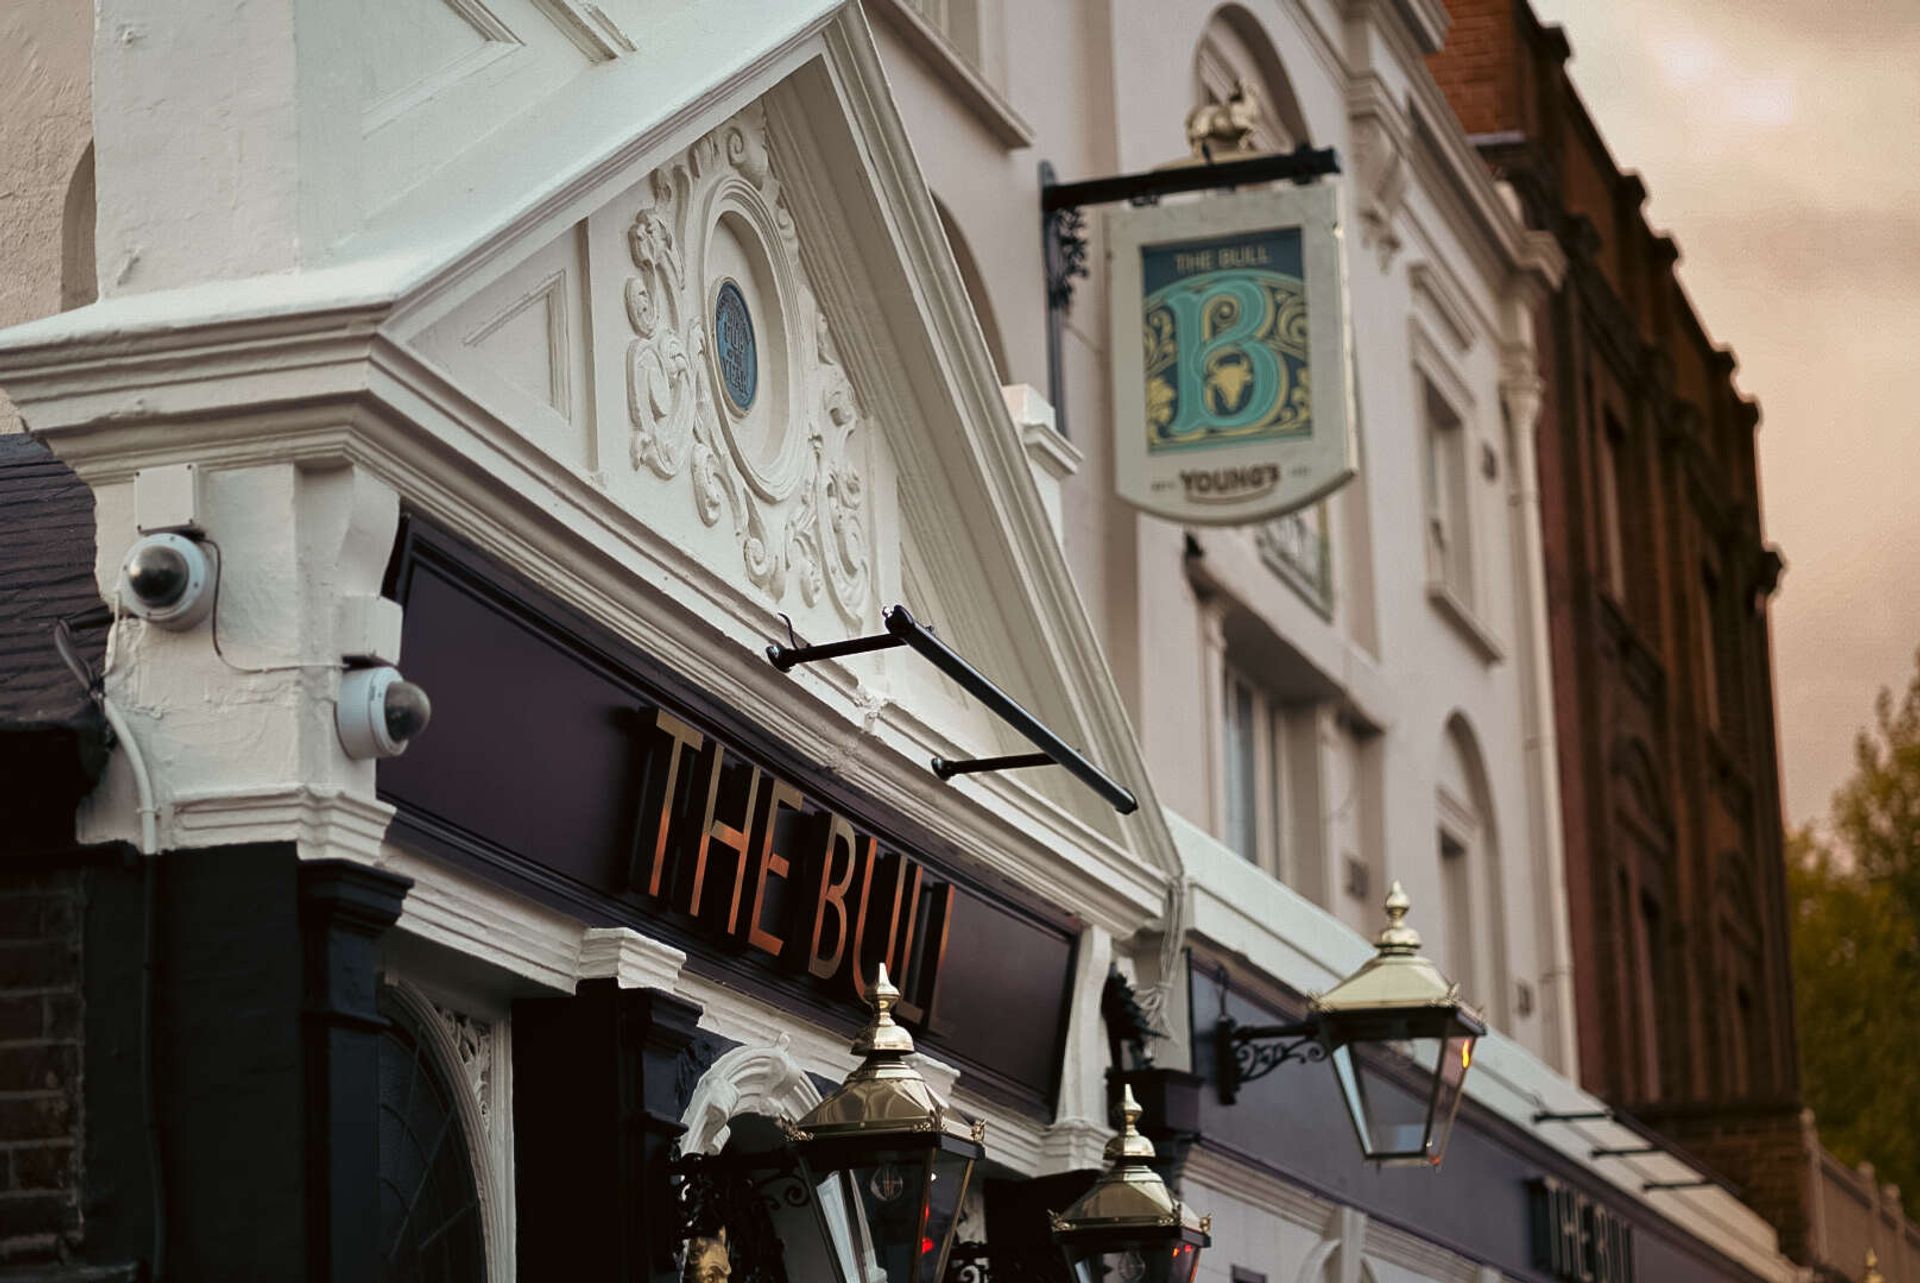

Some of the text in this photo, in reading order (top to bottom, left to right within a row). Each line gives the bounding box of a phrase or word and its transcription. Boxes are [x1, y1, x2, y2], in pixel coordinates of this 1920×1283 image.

[1175, 244, 1270, 274] THE BULL
[649, 707, 956, 1037] THE BULL
